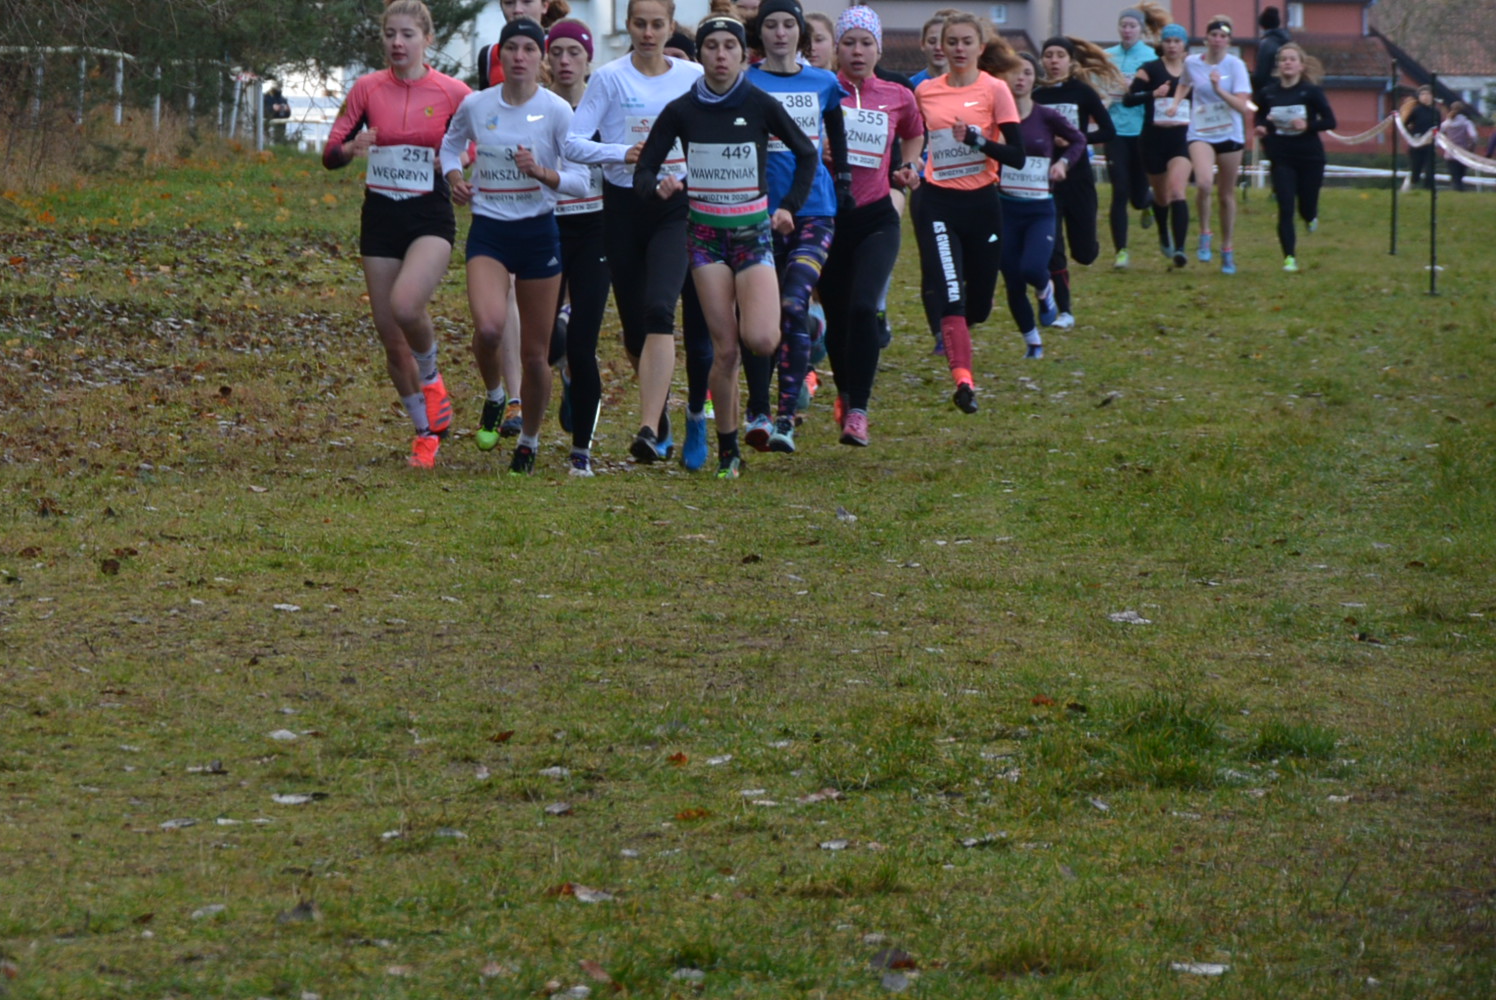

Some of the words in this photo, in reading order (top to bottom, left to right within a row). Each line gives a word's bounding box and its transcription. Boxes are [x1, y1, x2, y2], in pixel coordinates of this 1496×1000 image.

[786, 95, 813, 107] 388
[857, 110, 884, 126] 555
[845, 128, 882, 146] ŹNIAK
[402, 148, 429, 163] 251
[721, 145, 752, 160] 449
[1029, 159, 1042, 169] 75
[372, 165, 429, 182] WĘGRZYN
[690, 167, 755, 180] WAWRZYNIAK
